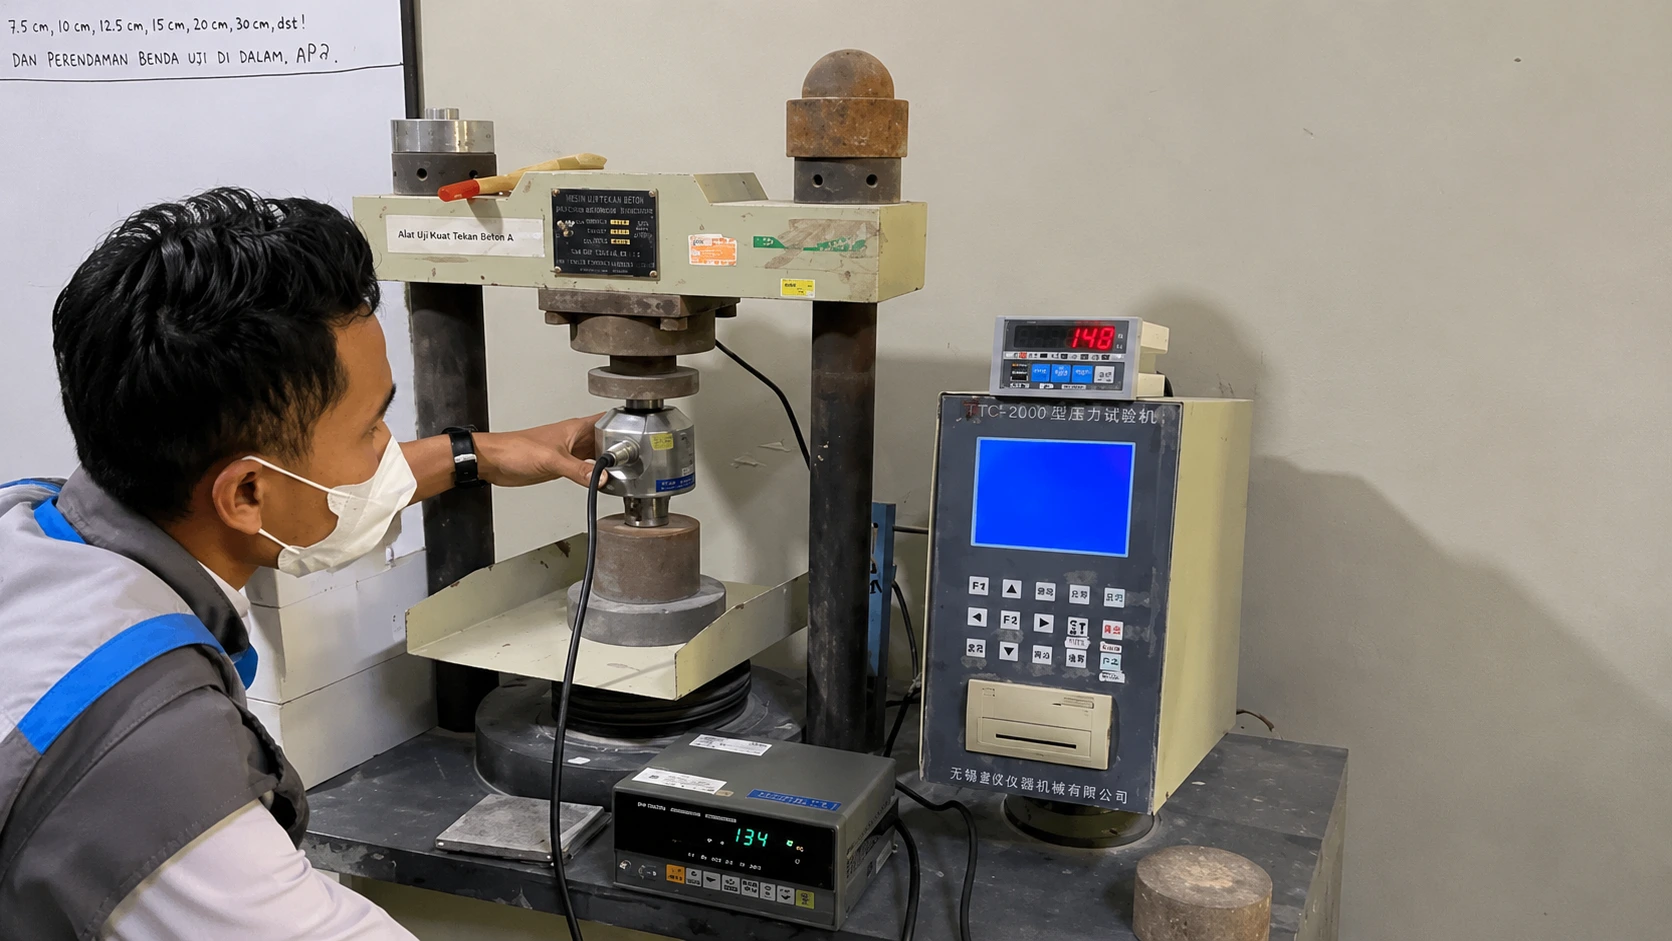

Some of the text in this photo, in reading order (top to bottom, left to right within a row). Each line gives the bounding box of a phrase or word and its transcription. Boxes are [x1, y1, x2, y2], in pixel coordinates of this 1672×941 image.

[8, 19, 28, 34] 7.5
[32, 22, 54, 37] cm,
[58, 19, 70, 33] 10
[74, 22, 96, 36] cm,
[99, 18, 123, 32] 12.5
[127, 22, 149, 36] cm,
[152, 18, 164, 32] 15
[167, 21, 190, 34] cm,
[193, 17, 208, 31] 20
[211, 21, 233, 33] cm,
[235, 16, 250, 30] 30
[12, 52, 37, 68] DAN
[47, 51, 128, 68] PERENDAMAN
[138, 50, 180, 67] BENDA
[188, 51, 207, 66] UJI
[217, 50, 230, 64] DI
[239, 50, 288, 65] DALAM.
[398, 228, 514, 242] Alat Uji Kuat Tekan Beton A
[1072, 327, 1115, 350] 148
[972, 581, 986, 591] F1
[1003, 615, 1018, 625] F2
[735, 827, 769, 847] 134
